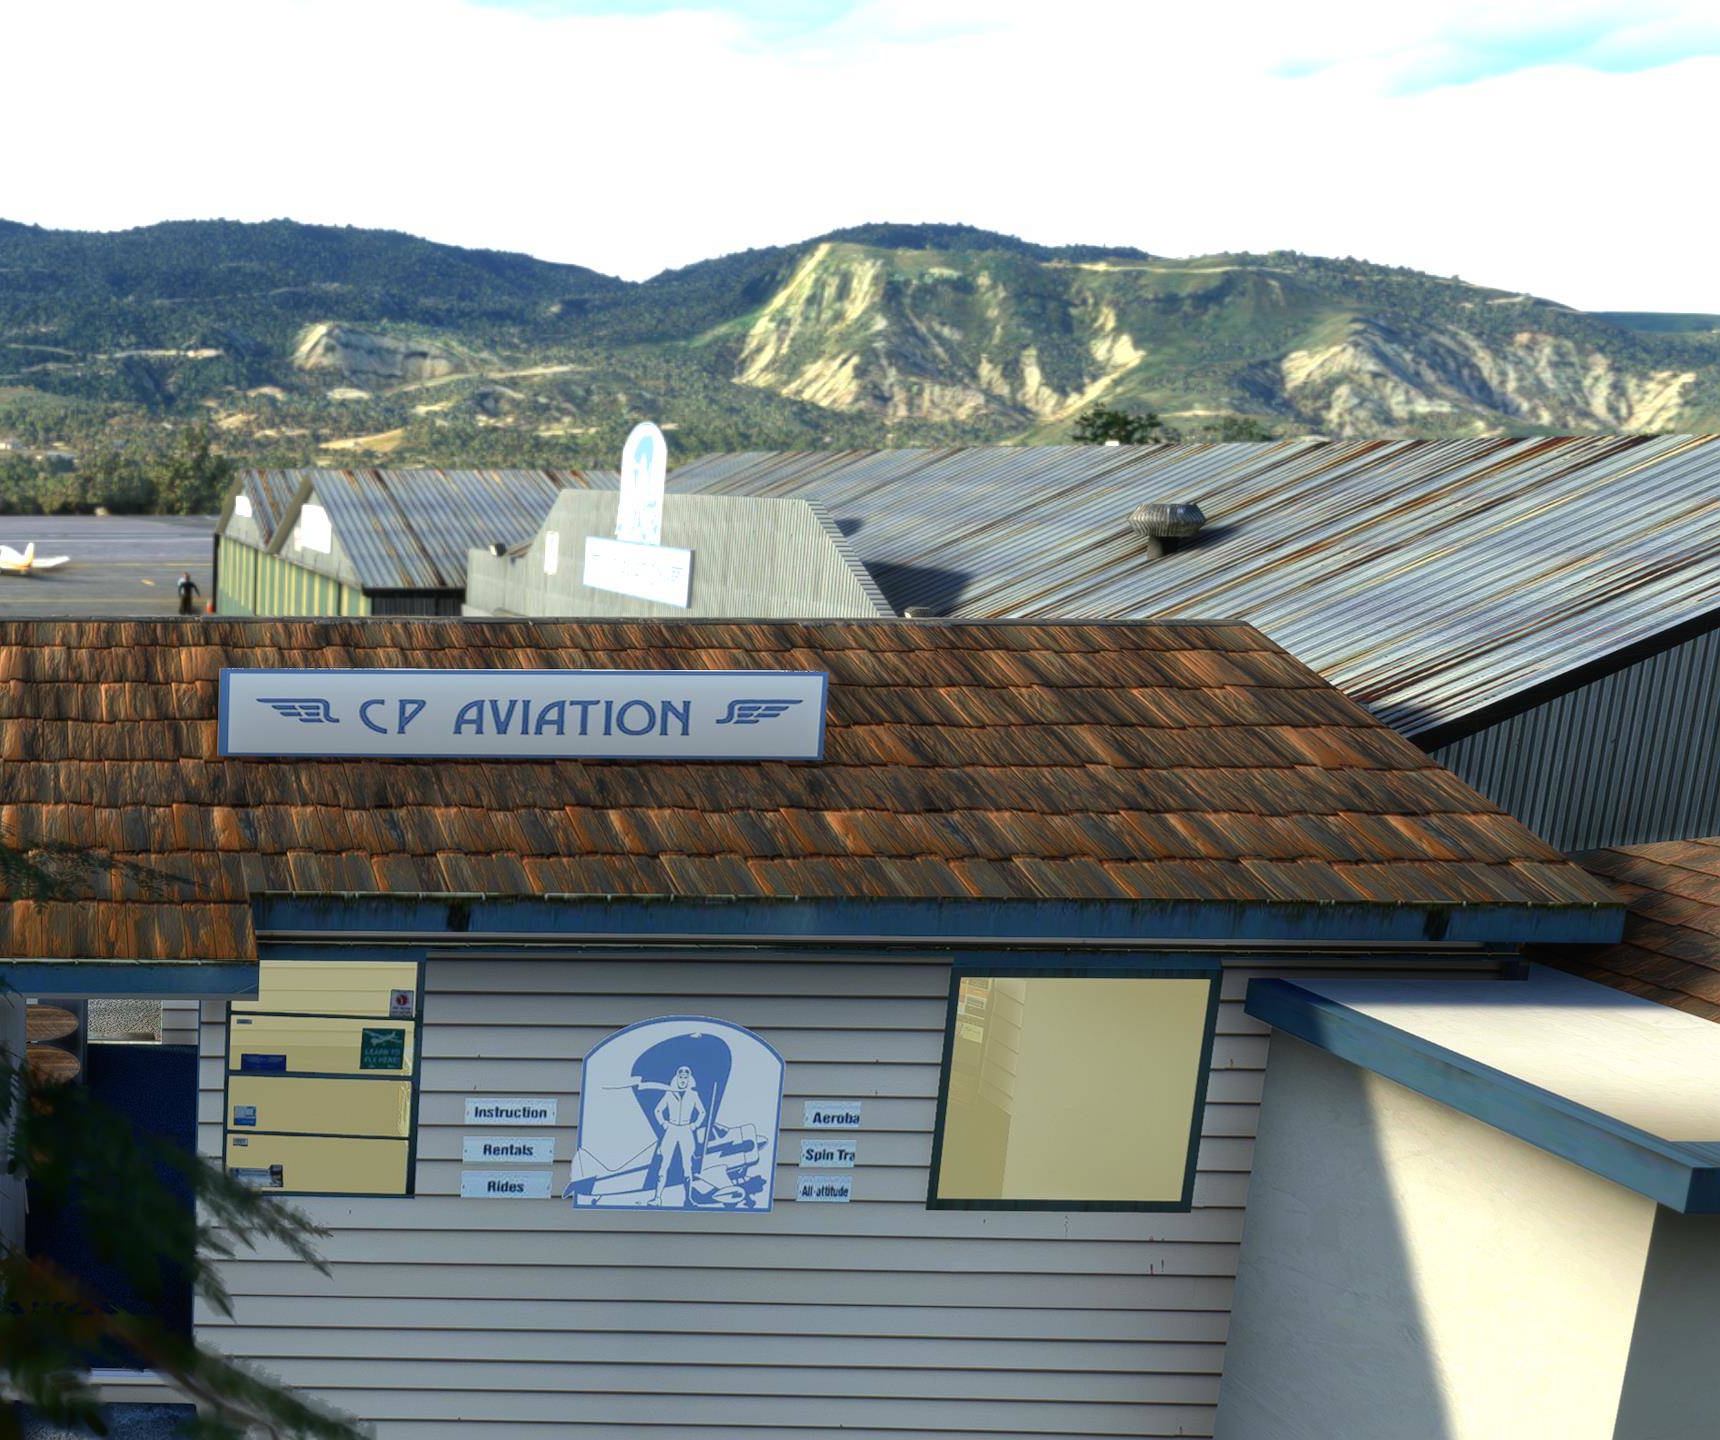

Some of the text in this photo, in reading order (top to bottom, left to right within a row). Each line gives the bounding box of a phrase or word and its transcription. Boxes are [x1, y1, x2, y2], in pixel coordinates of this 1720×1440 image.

[359, 699, 692, 736] CP AVIATION
[474, 1106, 547, 1118] Instruction
[812, 1111, 860, 1124] Aeroba
[483, 1144, 534, 1156] Rentals
[805, 1148, 834, 1162] Spin
[487, 1180, 525, 1193] Rides
